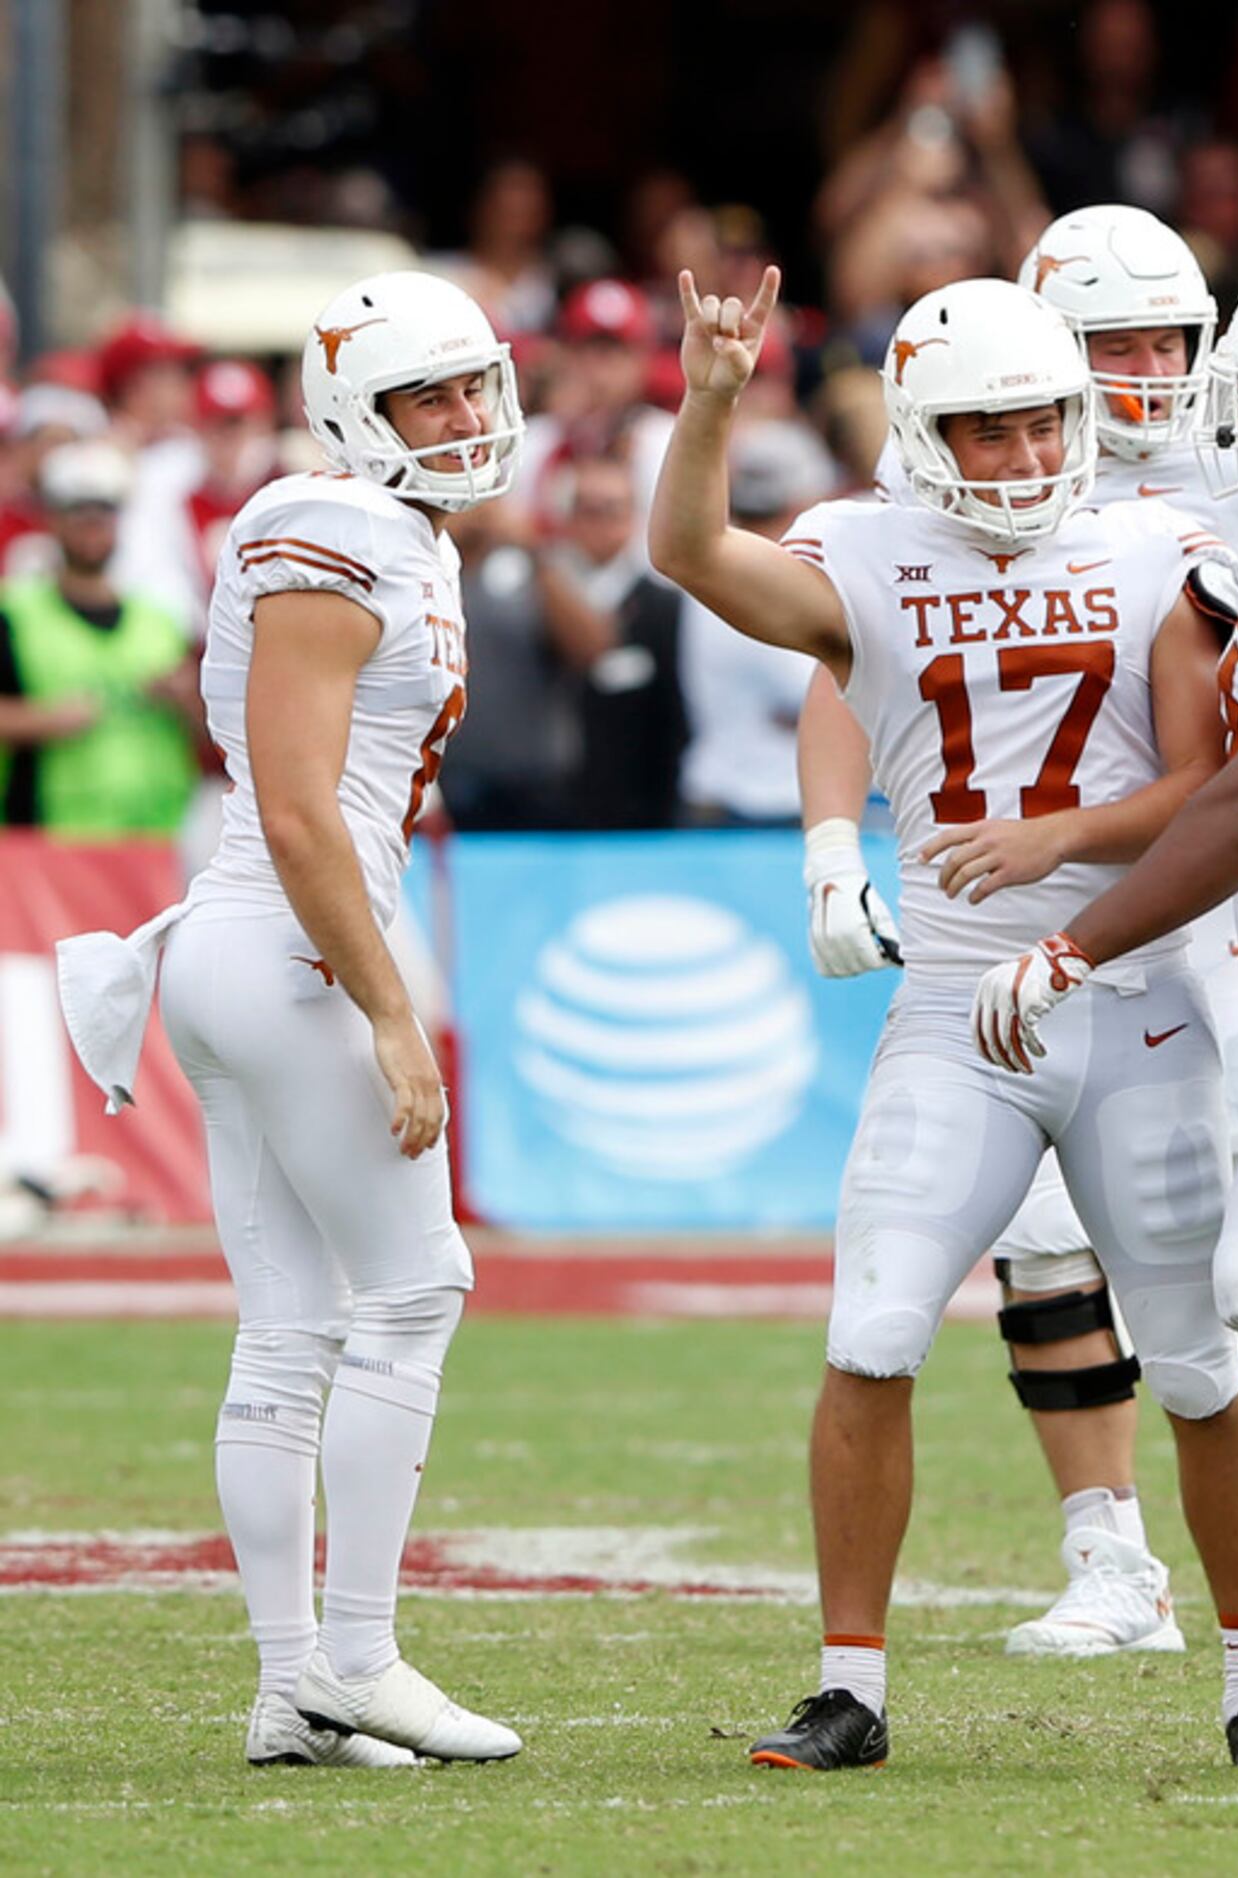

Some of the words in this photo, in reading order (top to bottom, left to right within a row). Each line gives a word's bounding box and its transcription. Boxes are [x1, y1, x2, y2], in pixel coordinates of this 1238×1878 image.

[895, 564, 933, 584] XII
[900, 586, 1120, 648] TEXAS
[918, 639, 1116, 825] 17
